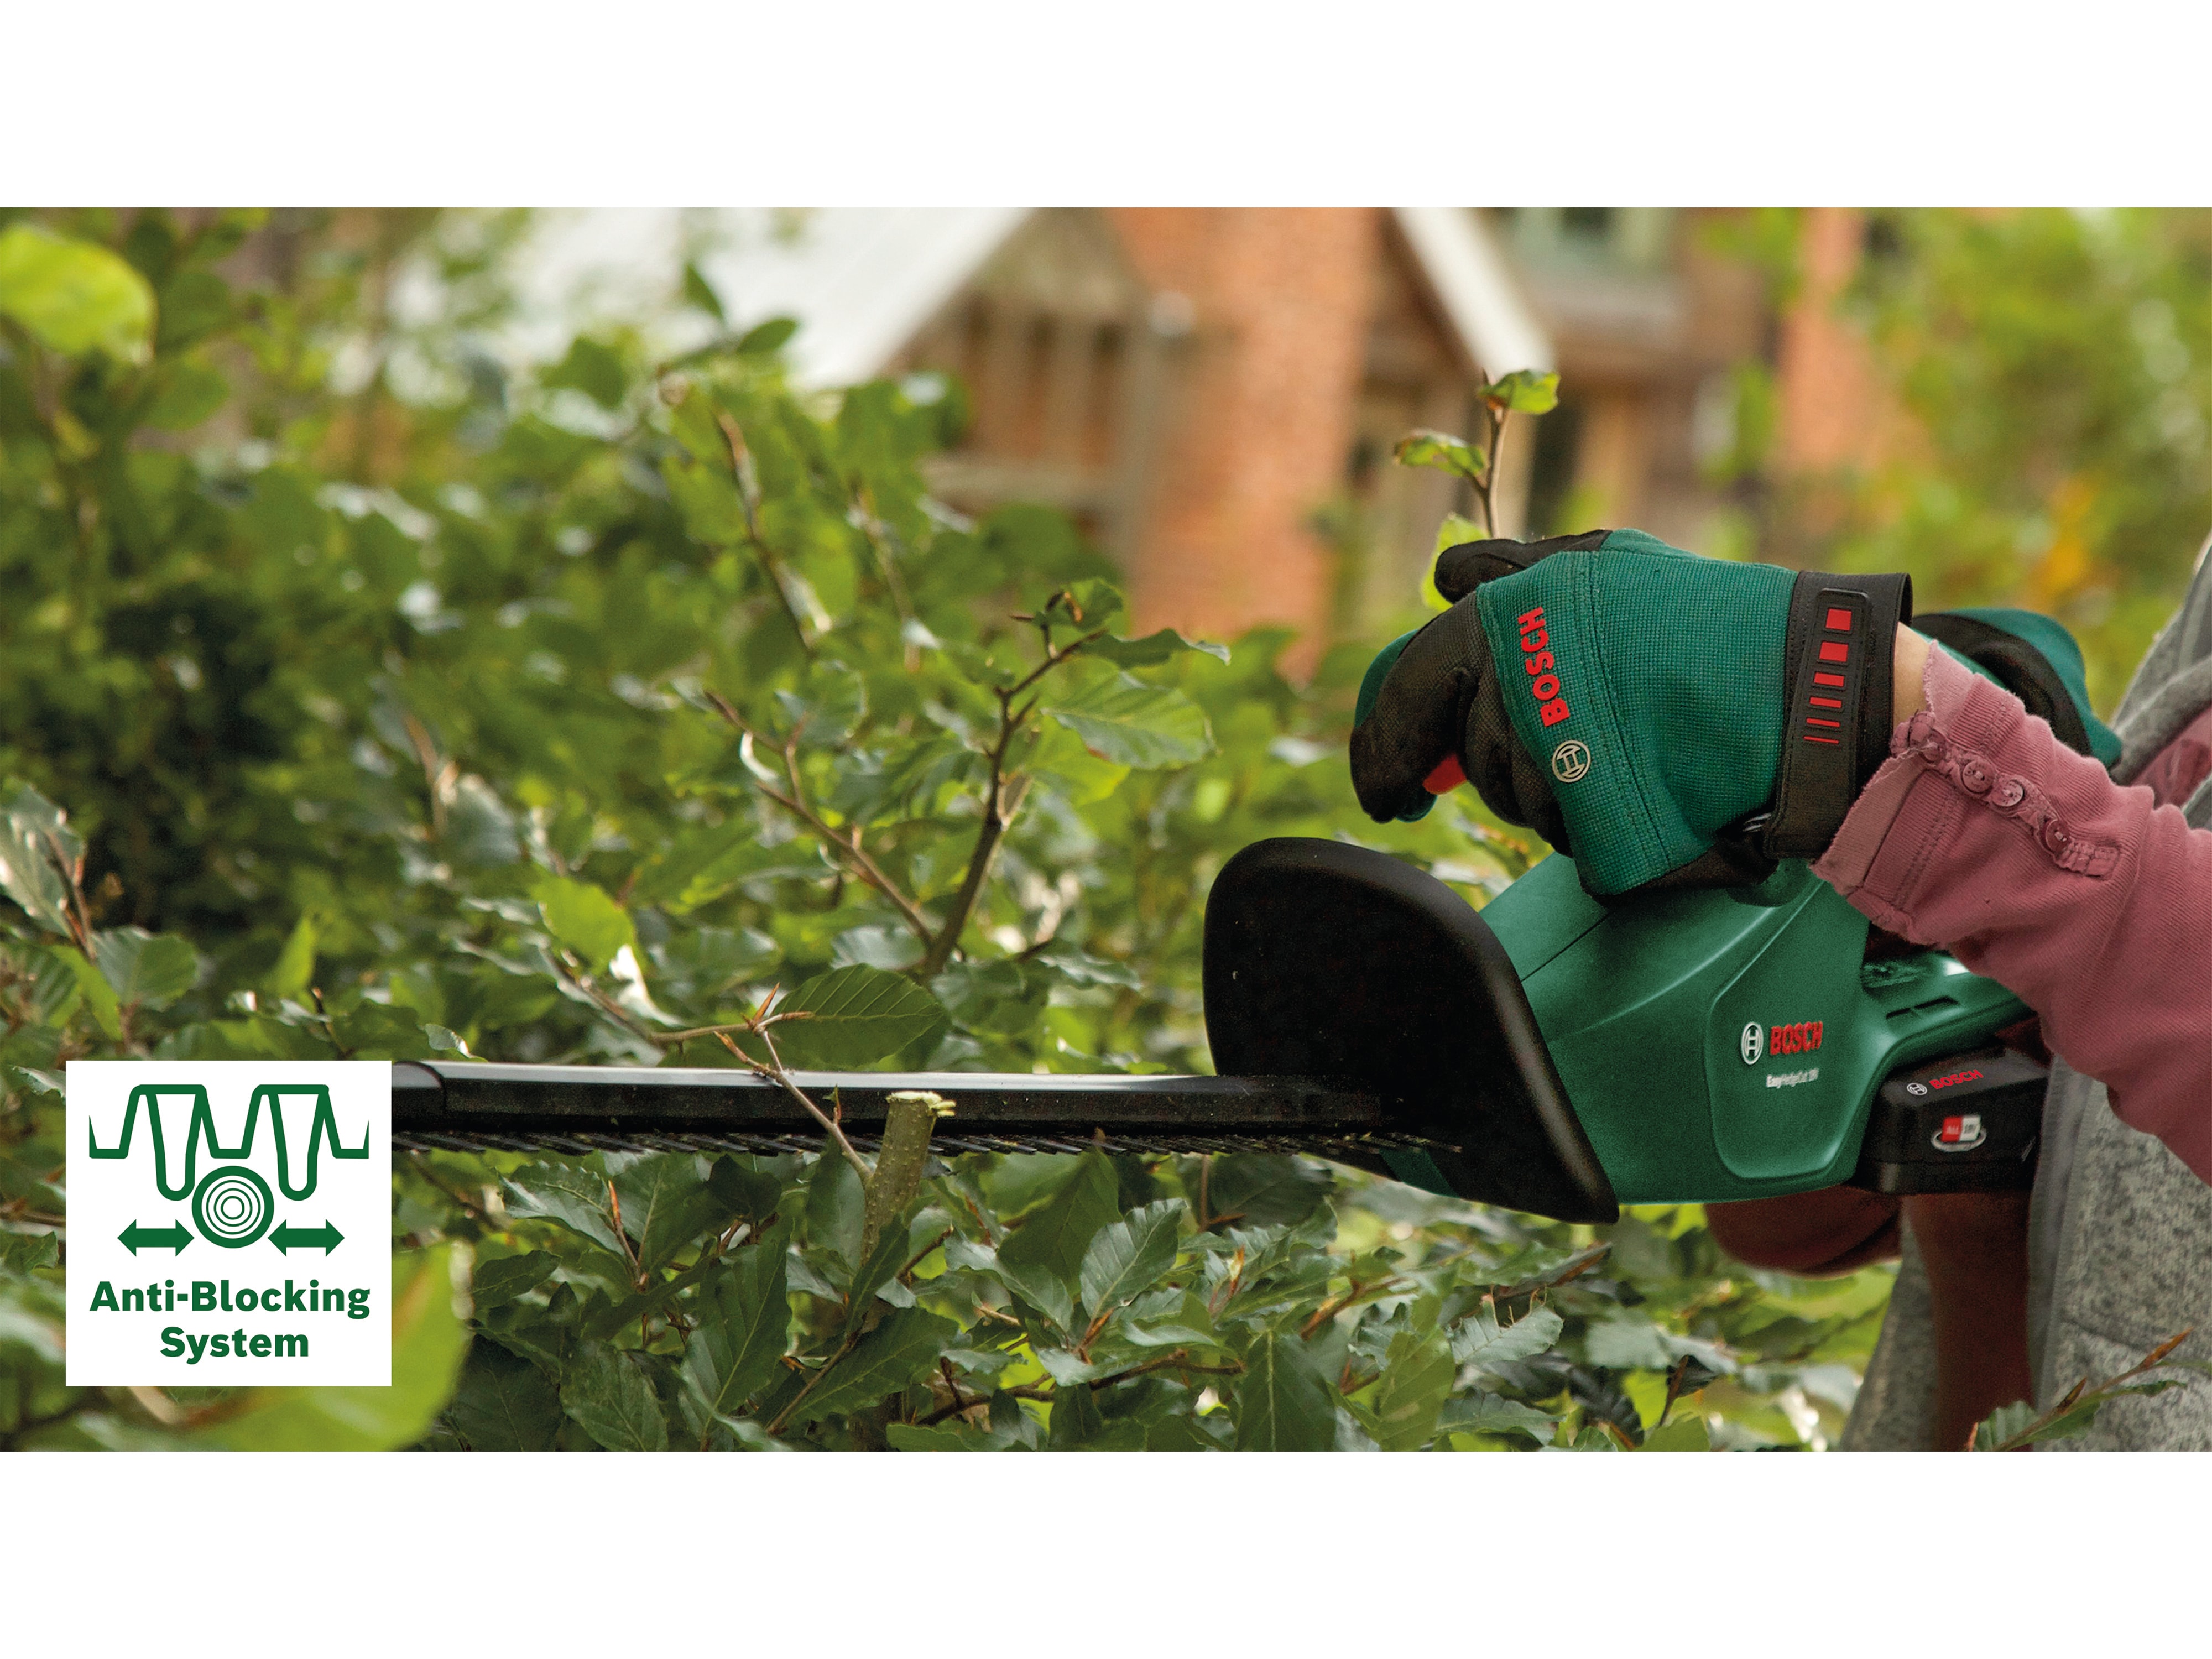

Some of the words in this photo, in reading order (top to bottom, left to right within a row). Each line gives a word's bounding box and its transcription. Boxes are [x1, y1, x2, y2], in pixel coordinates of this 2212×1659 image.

[1517, 606, 1570, 727] BOSCH
[1770, 1020, 1823, 1055] BOSCH
[1928, 1069, 1984, 1089] BOSCH
